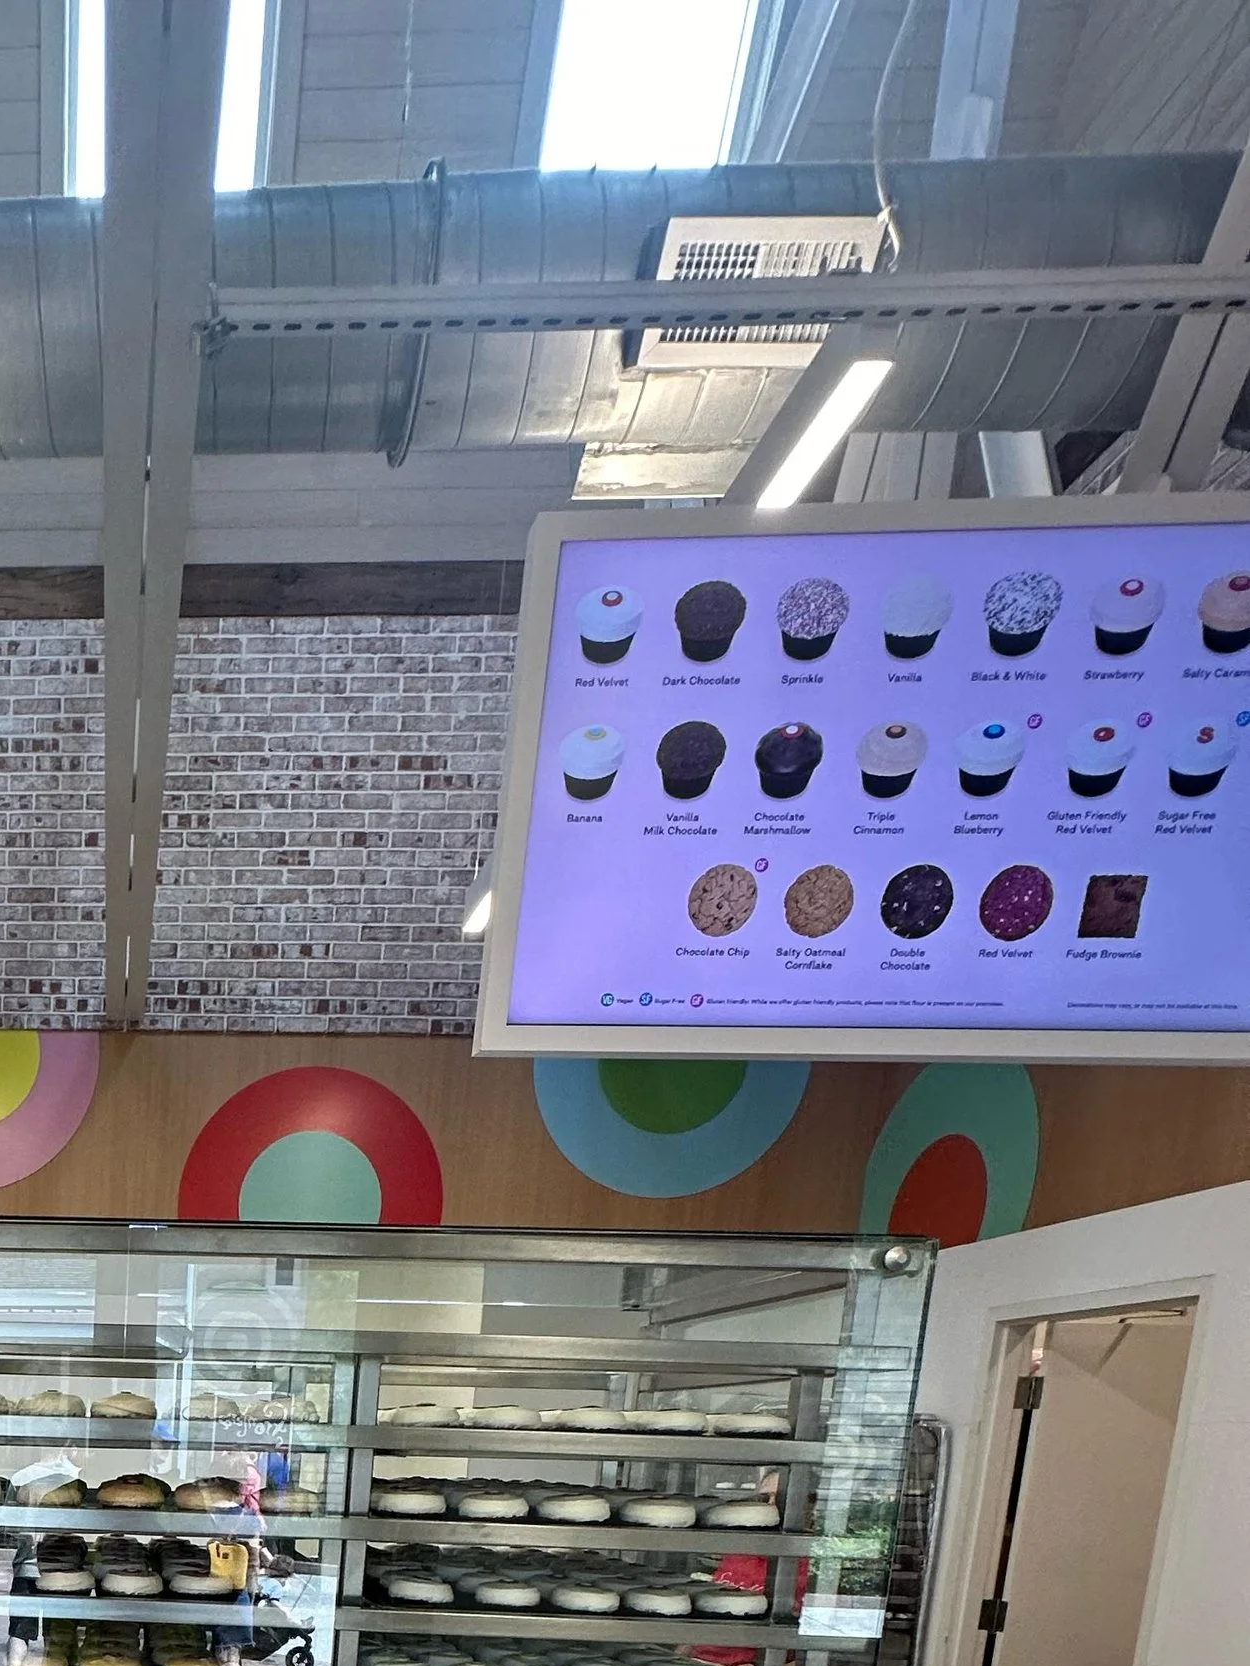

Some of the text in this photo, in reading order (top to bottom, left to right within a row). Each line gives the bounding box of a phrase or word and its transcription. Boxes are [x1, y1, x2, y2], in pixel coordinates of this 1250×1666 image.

[887, 672, 922, 683] Vanilla
[970, 670, 1047, 682] Black & White
[1083, 669, 1145, 682] Strawberry
[1182, 667, 1212, 681] Salty
[575, 677, 629, 688] Red Velvet
[662, 675, 741, 686] Dark Chocolate
[781, 674, 824, 687] Sprinkle
[566, 813, 603, 823] Banana
[665, 812, 700, 823] Vanilla
[754, 812, 805, 823] Chocolate
[866, 812, 896, 824] Triple
[963, 811, 999, 821] Lemon
[1047, 810, 1127, 823] Gluten Friendly
[1157, 811, 1217, 823] Sugar Free
[643, 825, 718, 836] Milk Chocolate
[743, 825, 811, 836] Marshmallow
[853, 825, 904, 835] Cinnamon
[953, 825, 1004, 837] Blueberry
[1055, 824, 1113, 835] Red Velvet
[1154, 824, 1213, 835] Red Velvet
[675, 947, 750, 959] Chocolate Chip
[775, 947, 846, 959] Salty Oatmeal
[889, 947, 925, 958] Double
[978, 948, 1033, 958] Red Velvet
[1065, 949, 1142, 961] Fudge Brownie
[784, 960, 832, 970] Cornflake
[880, 960, 931, 971] Chocolate
